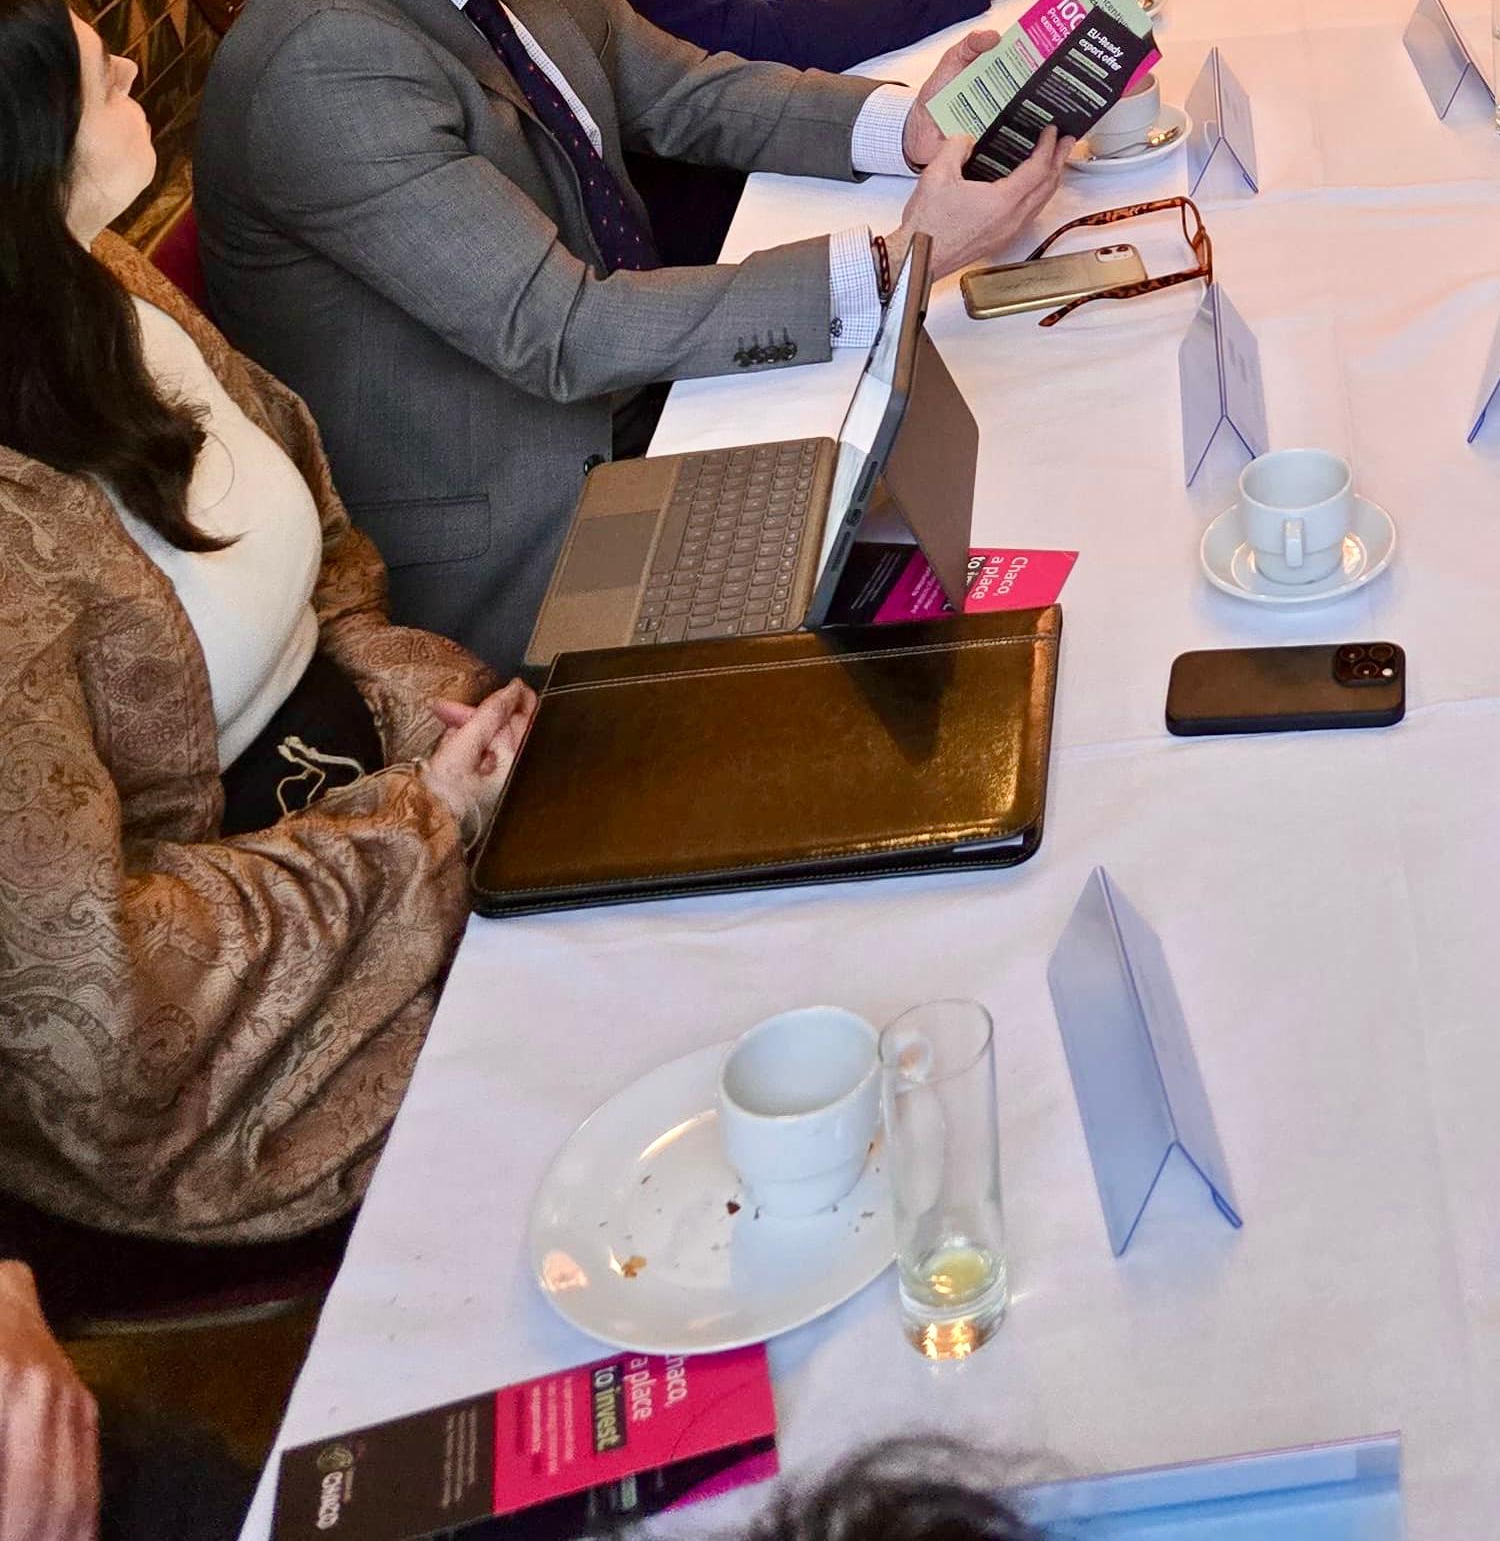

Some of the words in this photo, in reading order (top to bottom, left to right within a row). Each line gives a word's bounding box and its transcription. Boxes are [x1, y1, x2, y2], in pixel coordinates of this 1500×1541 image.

[991, 556, 1004, 564] a
[992, 556, 1029, 597] Chaco,
[971, 566, 1000, 600] place
[630, 1357, 648, 1369] a
[664, 1355, 688, 1408] haco,
[624, 1371, 657, 1422] place
